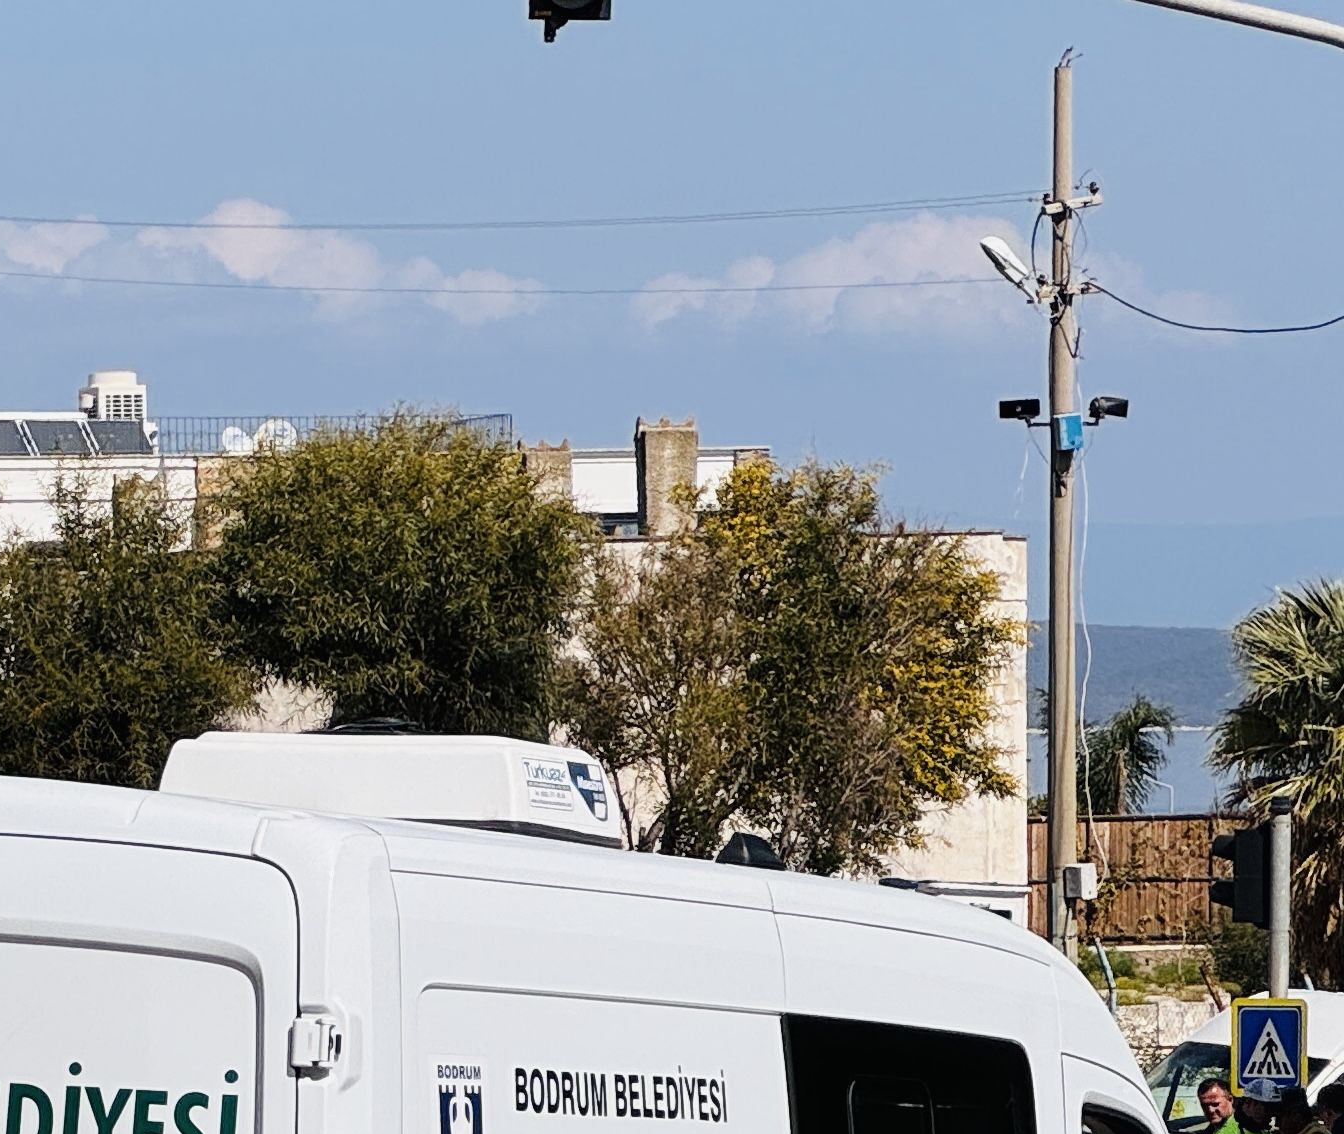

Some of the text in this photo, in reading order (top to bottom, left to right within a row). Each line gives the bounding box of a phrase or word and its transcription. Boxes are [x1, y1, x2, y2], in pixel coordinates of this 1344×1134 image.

[437, 1064, 482, 1080] BODRUM
[514, 1064, 729, 1123] BODRUM BELEDİYESİ
